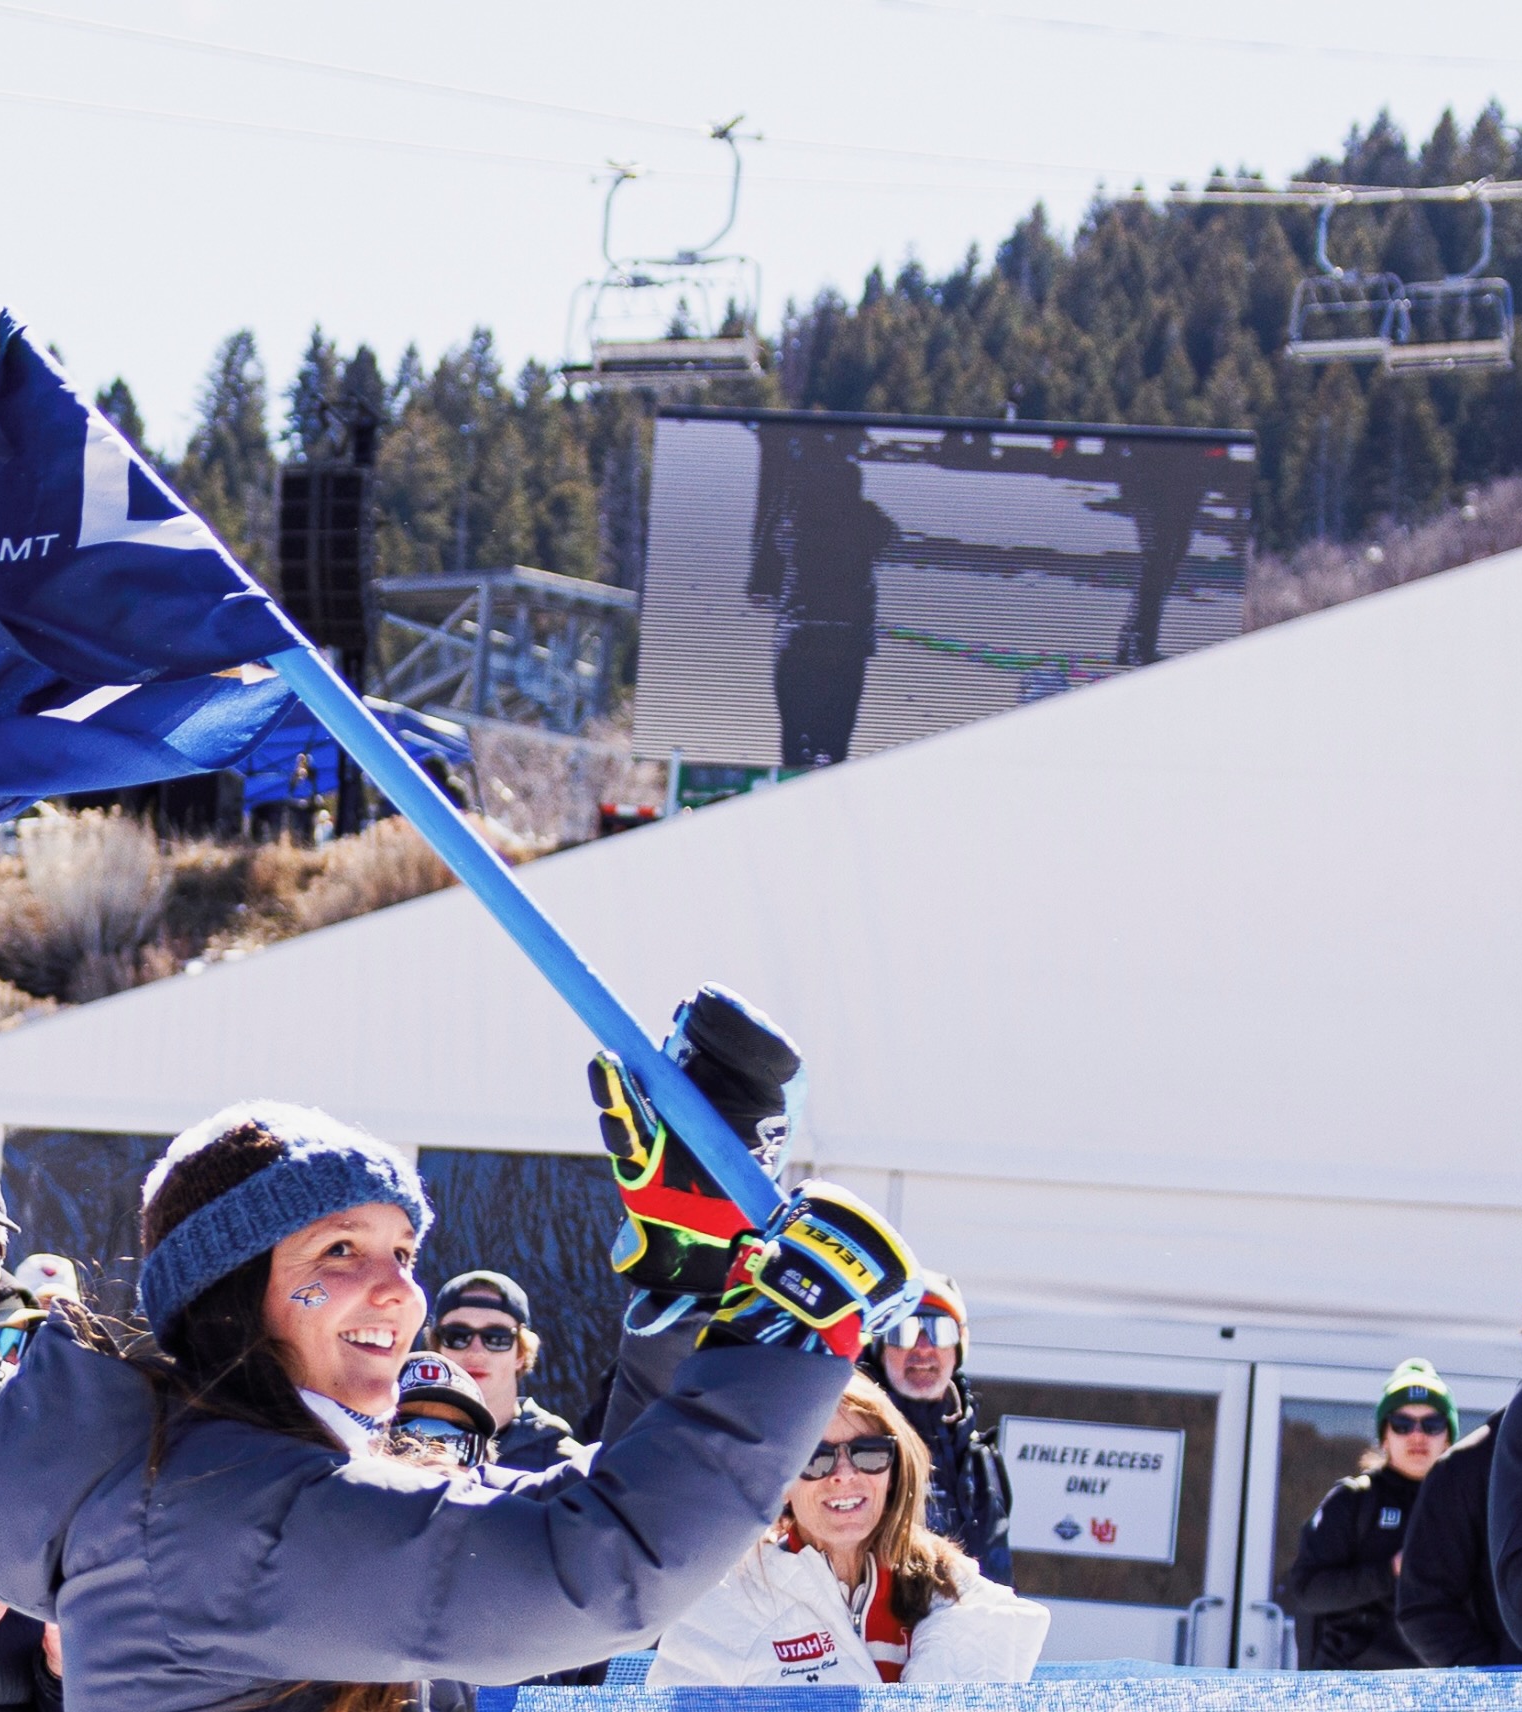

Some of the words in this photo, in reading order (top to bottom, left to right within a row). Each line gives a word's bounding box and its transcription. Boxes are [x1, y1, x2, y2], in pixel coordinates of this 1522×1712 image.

[804, 1225, 868, 1278] LEVEL
[784, 1268, 801, 1282] CUP
[780, 1276, 807, 1299] WORLD
[1017, 1443, 1091, 1466] ATHLETE
[1093, 1450, 1163, 1471] ACCESS
[1065, 1475, 1111, 1495] ONLY
[776, 1638, 821, 1658] UTAH
[820, 1631, 836, 1653] SKI
